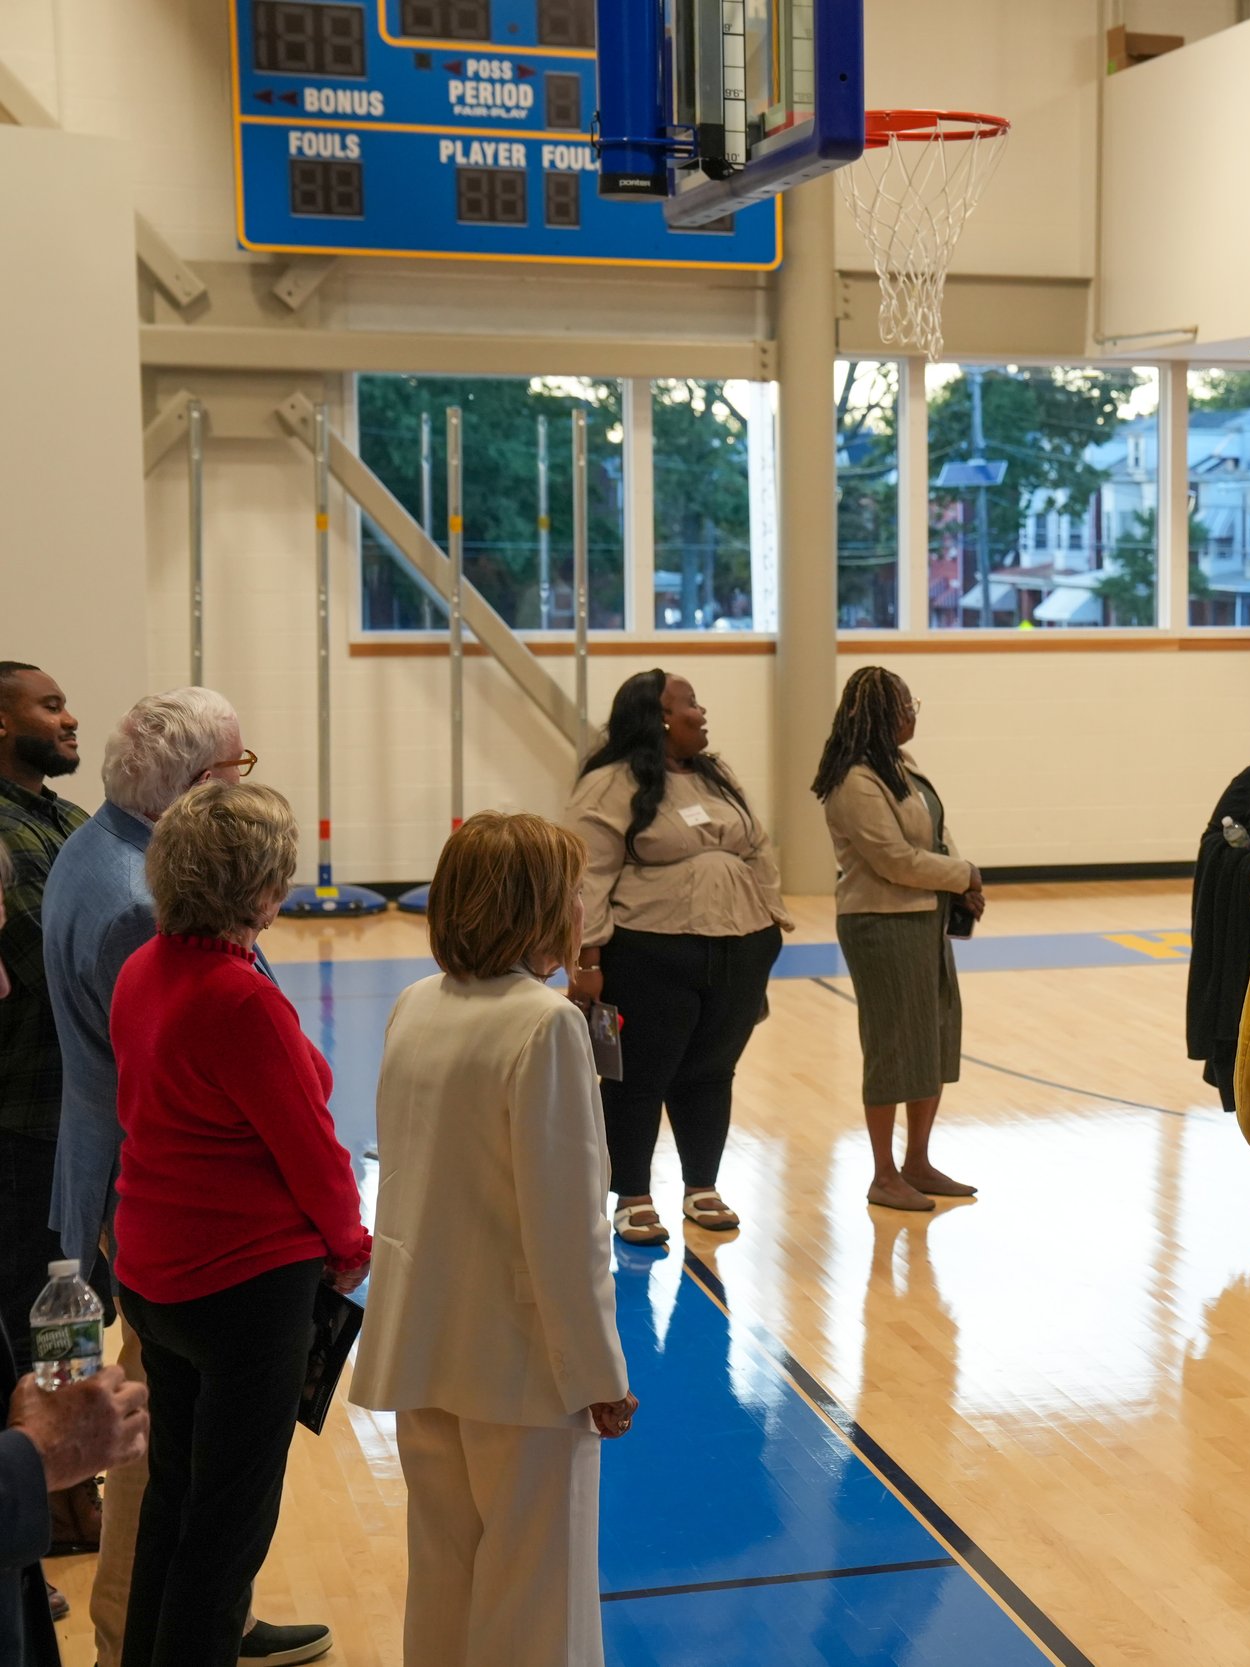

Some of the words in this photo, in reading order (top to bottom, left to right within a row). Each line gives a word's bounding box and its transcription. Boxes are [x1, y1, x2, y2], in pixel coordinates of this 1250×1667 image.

[466, 58, 513, 80] POSS
[303, 87, 384, 116] BONUS
[448, 79, 534, 108] PERIOD
[288, 131, 360, 158] FOULS
[439, 140, 526, 167] PLAYER
[541, 144, 600, 171] FOUL
